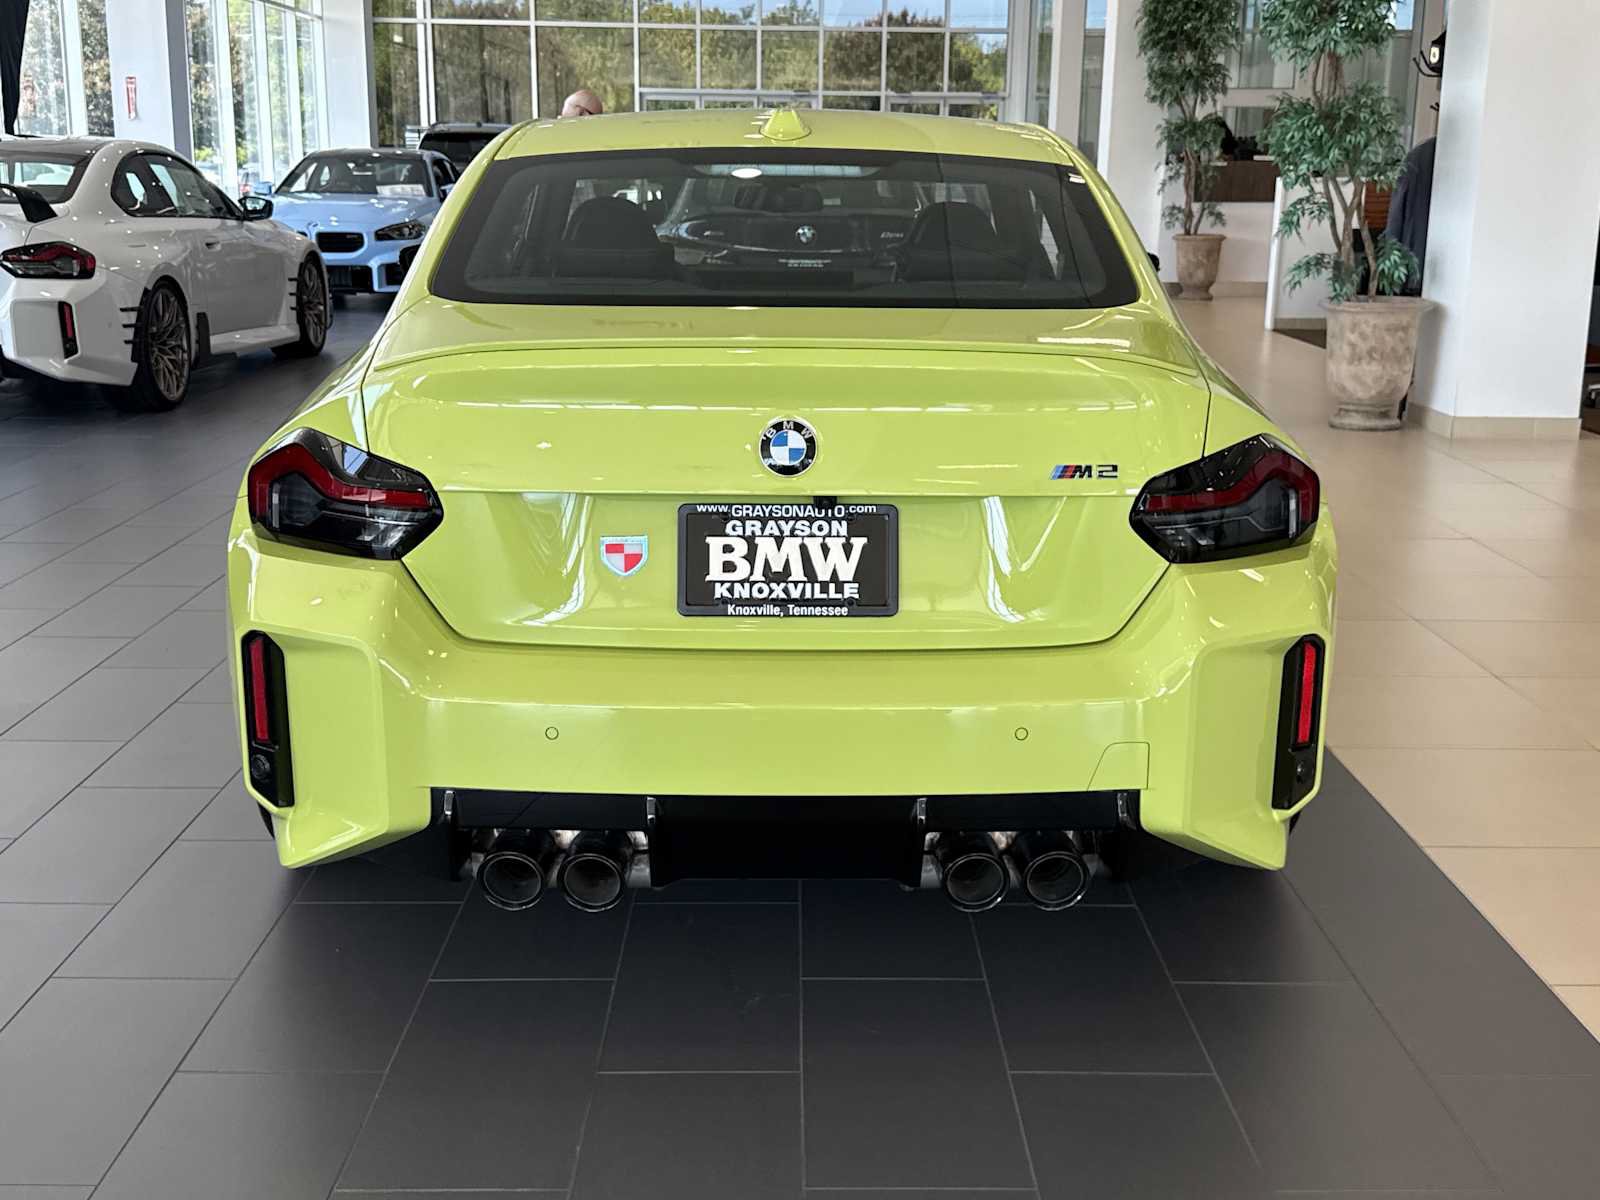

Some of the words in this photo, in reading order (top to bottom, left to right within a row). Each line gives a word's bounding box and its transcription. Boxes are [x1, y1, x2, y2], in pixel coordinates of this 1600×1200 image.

[765, 421, 812, 439] BMW
[1066, 464, 1118, 478] M2
[725, 520, 848, 536] GRAYSON
[705, 536, 867, 581] BMW
[714, 583, 860, 599] KNOXVILLE
[727, 604, 784, 617] Knoxville,
[787, 604, 848, 616] Tennessee
